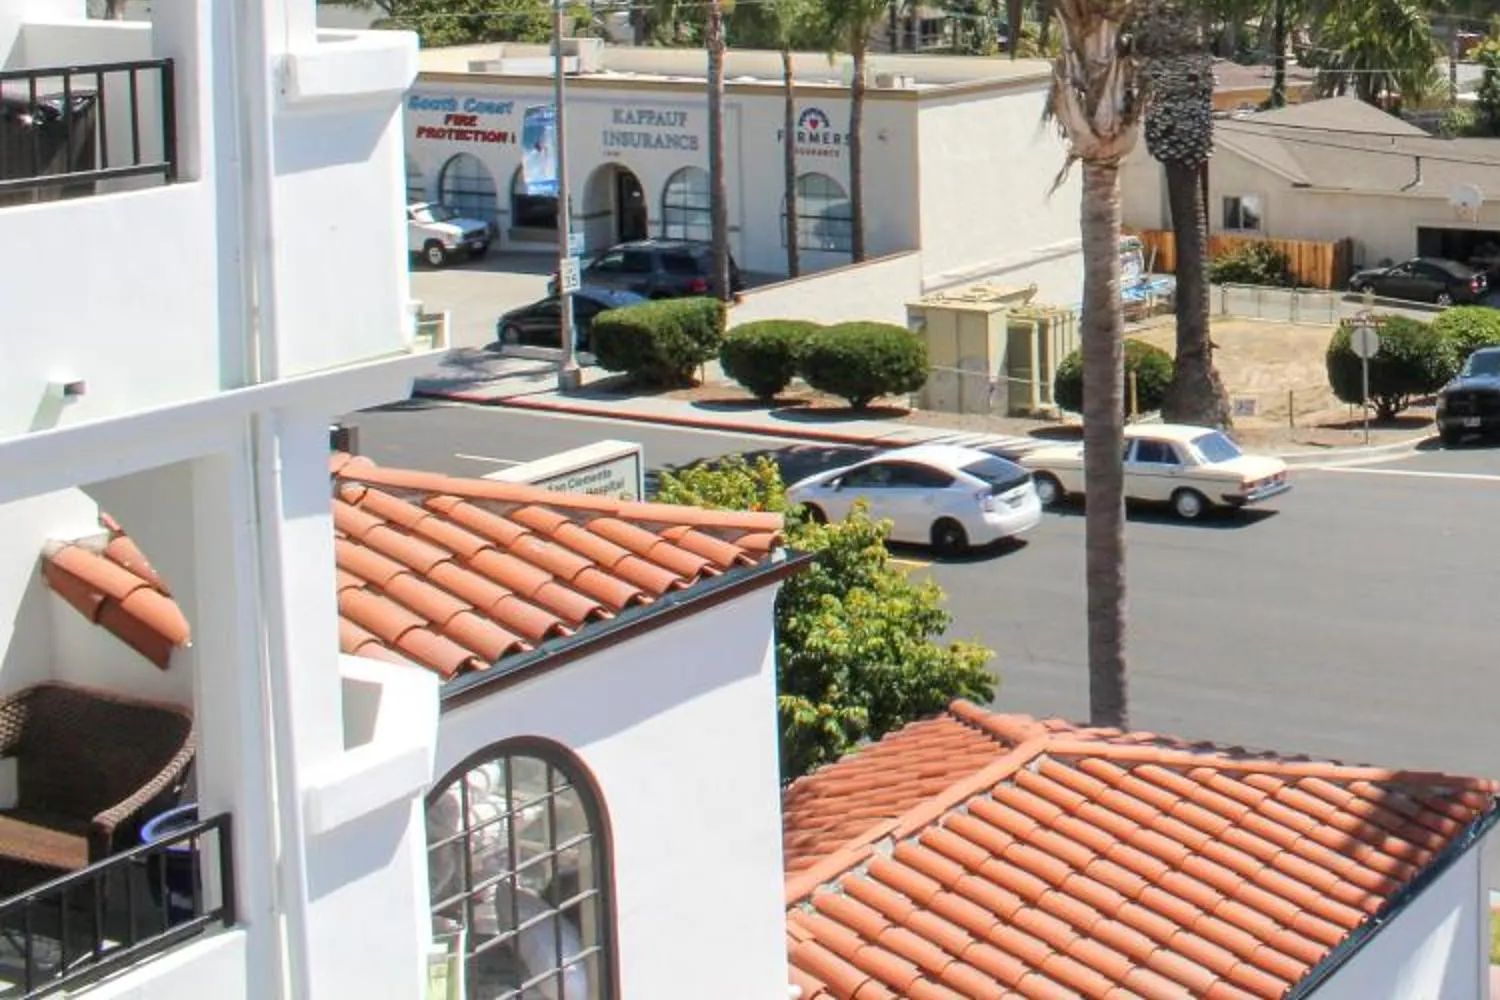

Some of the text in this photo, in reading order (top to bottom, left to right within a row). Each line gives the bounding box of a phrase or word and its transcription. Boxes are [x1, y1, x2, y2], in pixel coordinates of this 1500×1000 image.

[444, 113, 478, 127] FIRE
[416, 126, 508, 143] PROTECTION
[602, 131, 699, 151] INSURANCE
[777, 130, 850, 146] FRMERS
